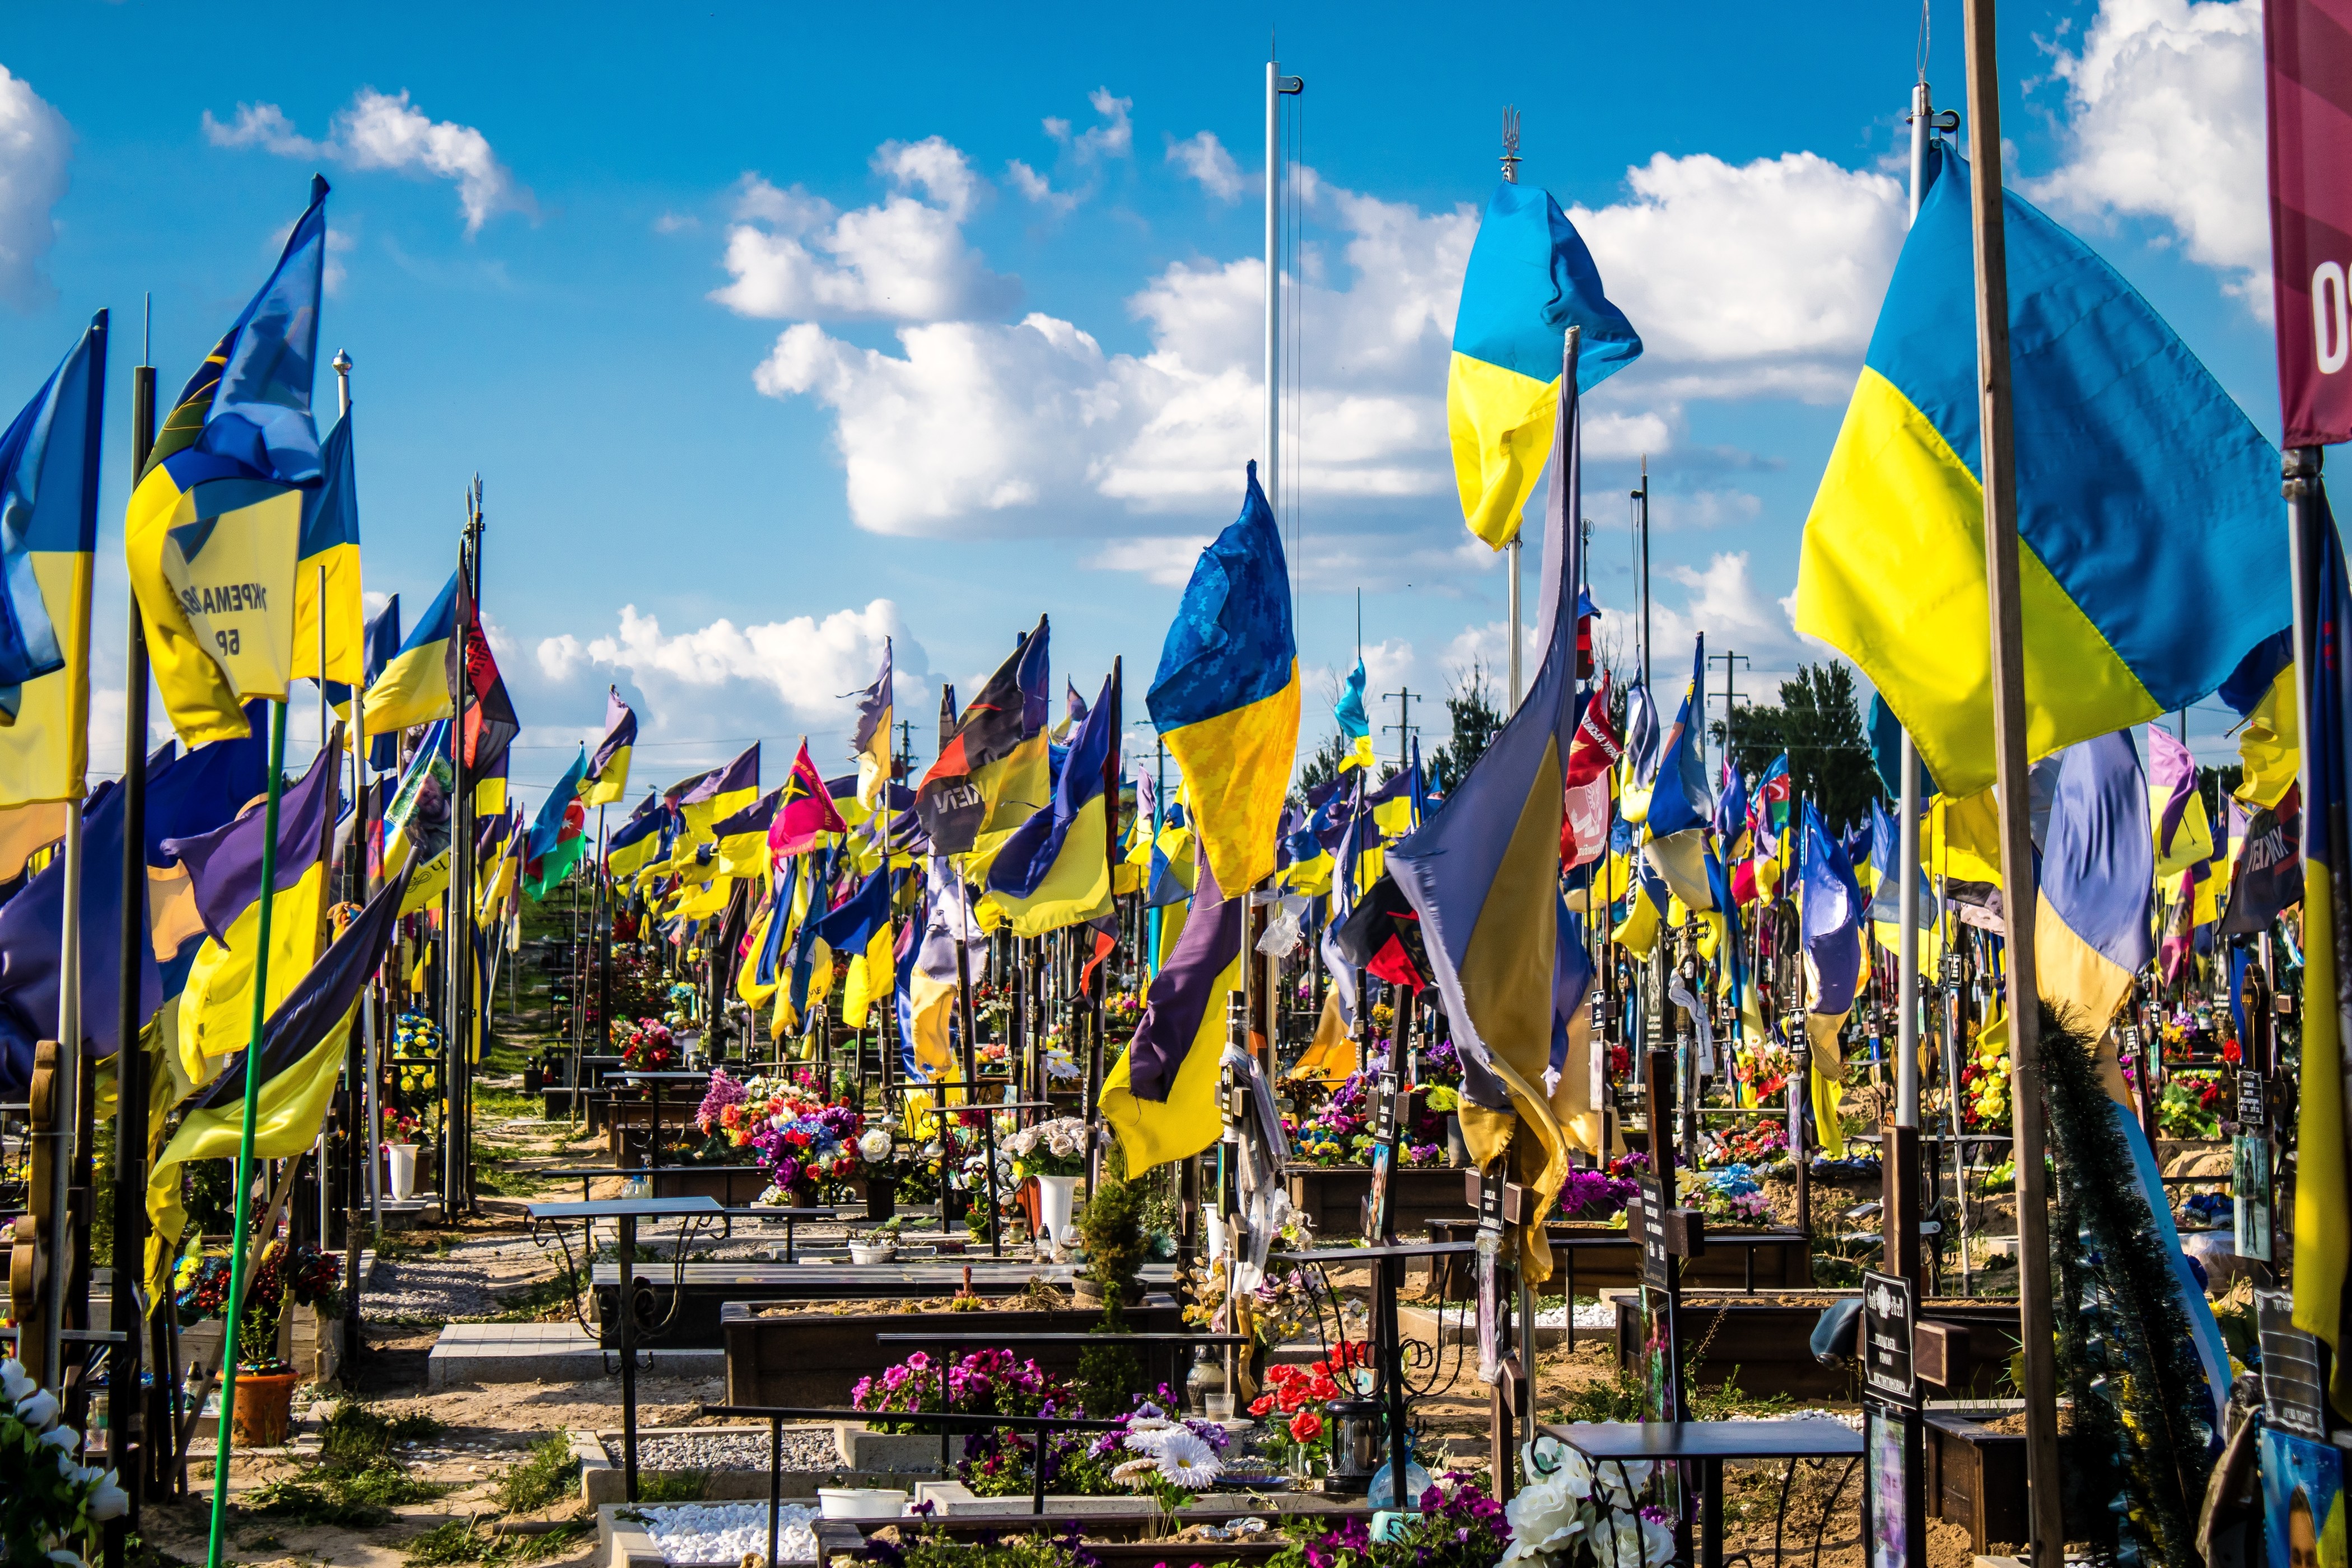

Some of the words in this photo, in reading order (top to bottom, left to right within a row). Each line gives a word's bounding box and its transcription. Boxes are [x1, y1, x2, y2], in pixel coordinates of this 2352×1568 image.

[1891, 1304, 1903, 1318] 2023
[1879, 1351, 1892, 1366] РОМАН
[1873, 1371, 1906, 1392] КОСТЯНТИНОВИЧ
